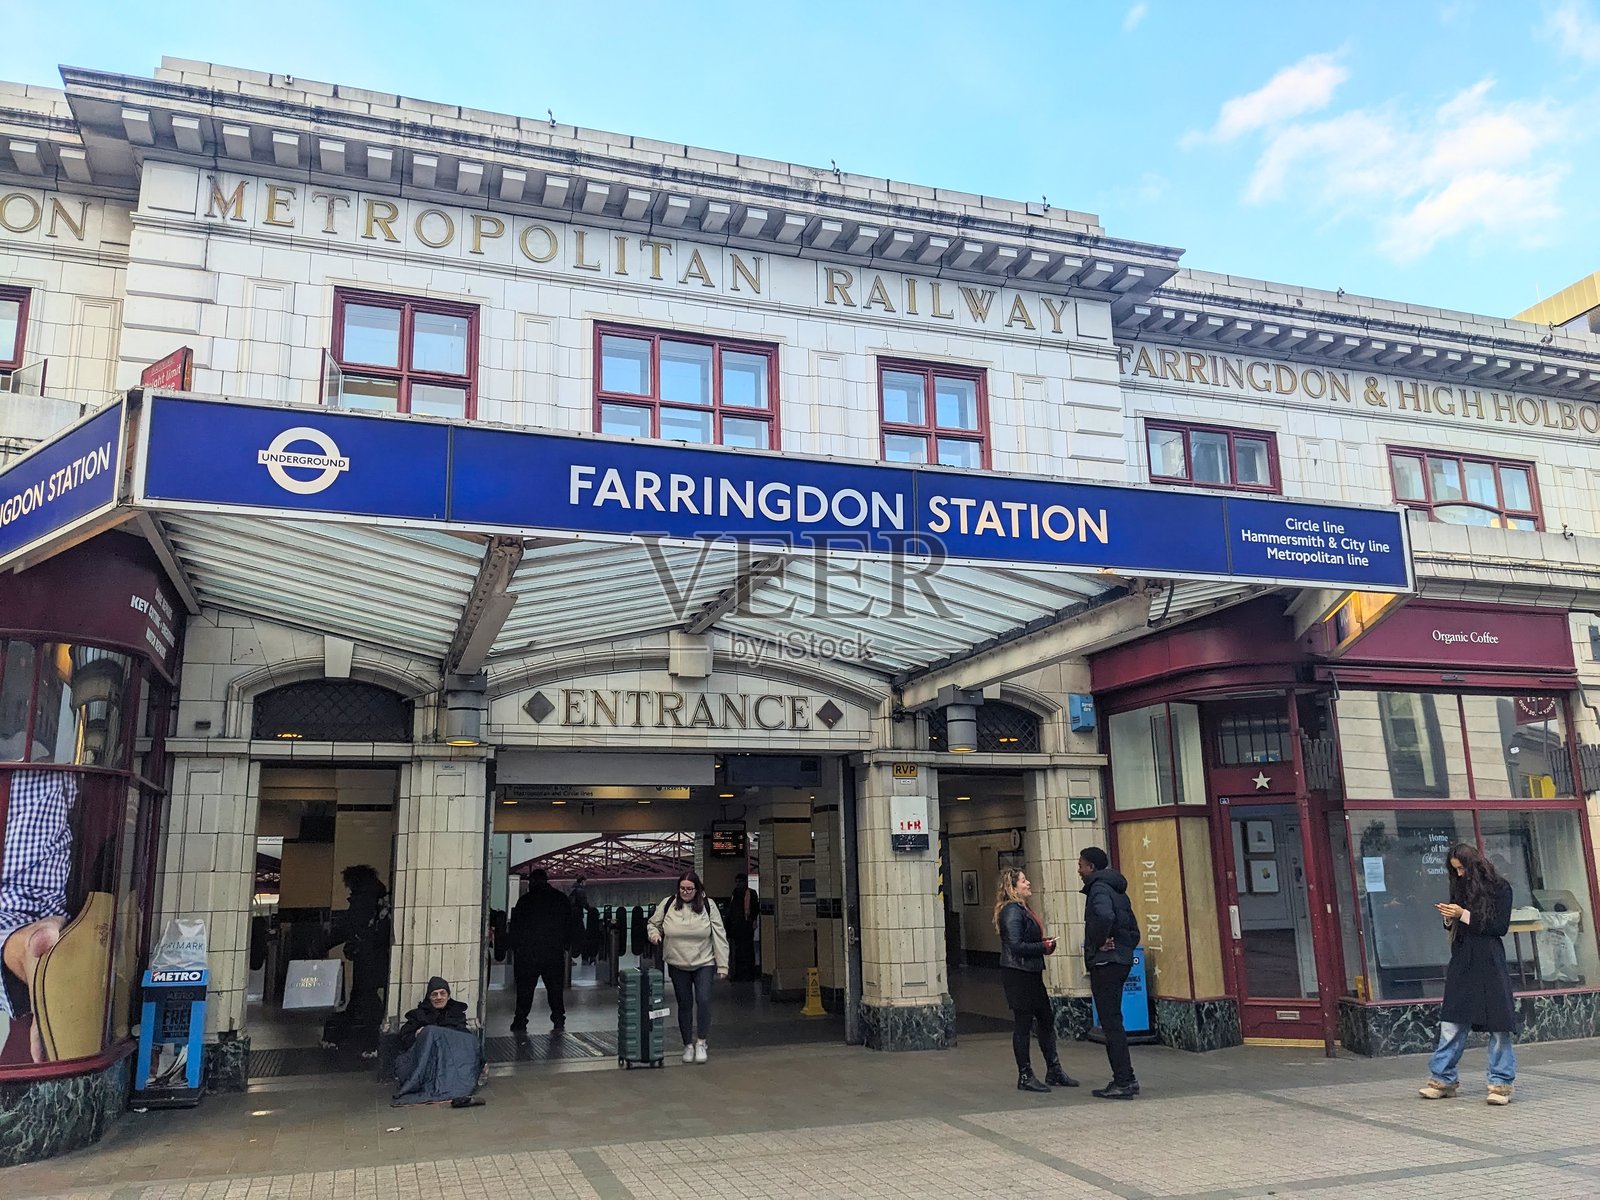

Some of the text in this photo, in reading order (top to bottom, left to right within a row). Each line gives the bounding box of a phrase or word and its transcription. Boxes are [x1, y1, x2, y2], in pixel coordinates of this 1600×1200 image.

[205, 175, 1071, 334] METROPOLITAN RAILWAY
[1114, 342, 1351, 403] FARRINGDON
[1363, 376, 1388, 407] &
[1395, 379, 1485, 419] HIGH
[261, 453, 346, 468] UNDERGROUND
[47, 441, 111, 502] STATION
[570, 464, 1108, 545] FARRINGDON STATION
[1285, 517, 1345, 534] Circle line
[1241, 529, 1390, 553] Hammersmith & City line
[1267, 547, 1369, 566] Metropolitan line
[130, 594, 150, 614] KEY
[1432, 629, 1499, 645] Organic Coffee
[561, 687, 811, 731] ENTRANCE
[895, 765, 916, 775] RVP
[1070, 803, 1093, 815] SAP
[1428, 833, 1449, 842] Home
[1142, 860, 1159, 904] PETIT
[1145, 914, 1163, 953] PRET
[153, 971, 201, 982] METRO
